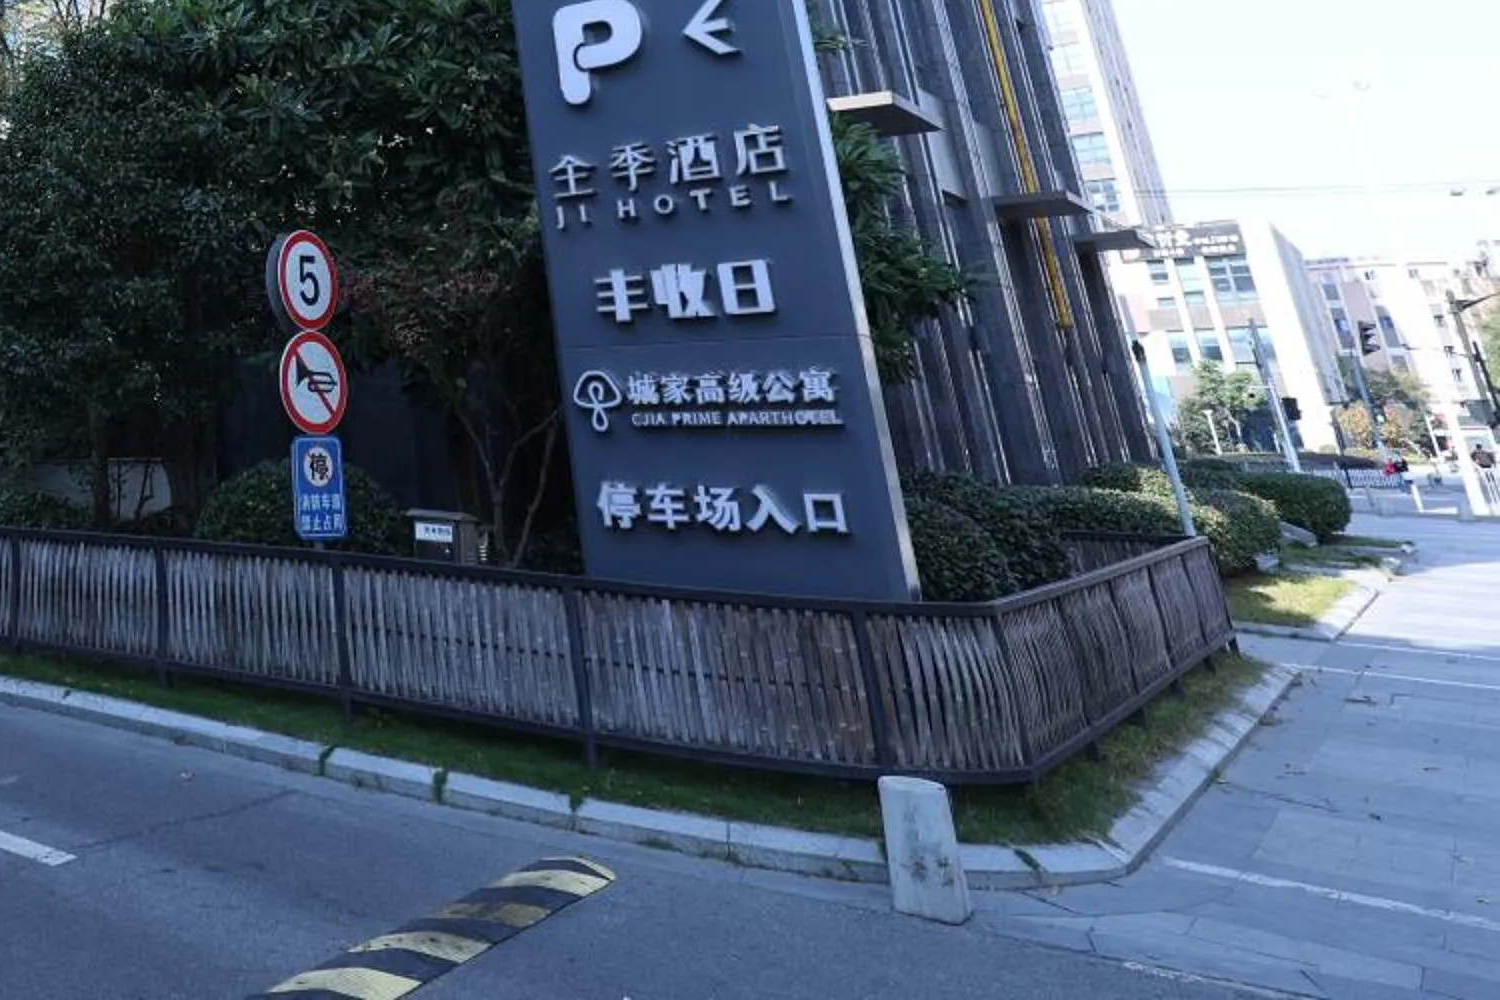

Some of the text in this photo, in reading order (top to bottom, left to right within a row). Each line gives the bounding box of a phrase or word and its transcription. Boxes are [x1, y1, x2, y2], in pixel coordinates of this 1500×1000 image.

[547, 122, 789, 199] 全季酒店
[554, 180, 792, 230] JI HOTEL
[297, 255, 321, 307] 5
[594, 258, 779, 323] 丰收日
[627, 368, 837, 406] 城家高级公寓
[631, 411, 666, 427] CJIA
[671, 410, 722, 426] PRIME
[597, 481, 850, 535] 停车场入口
